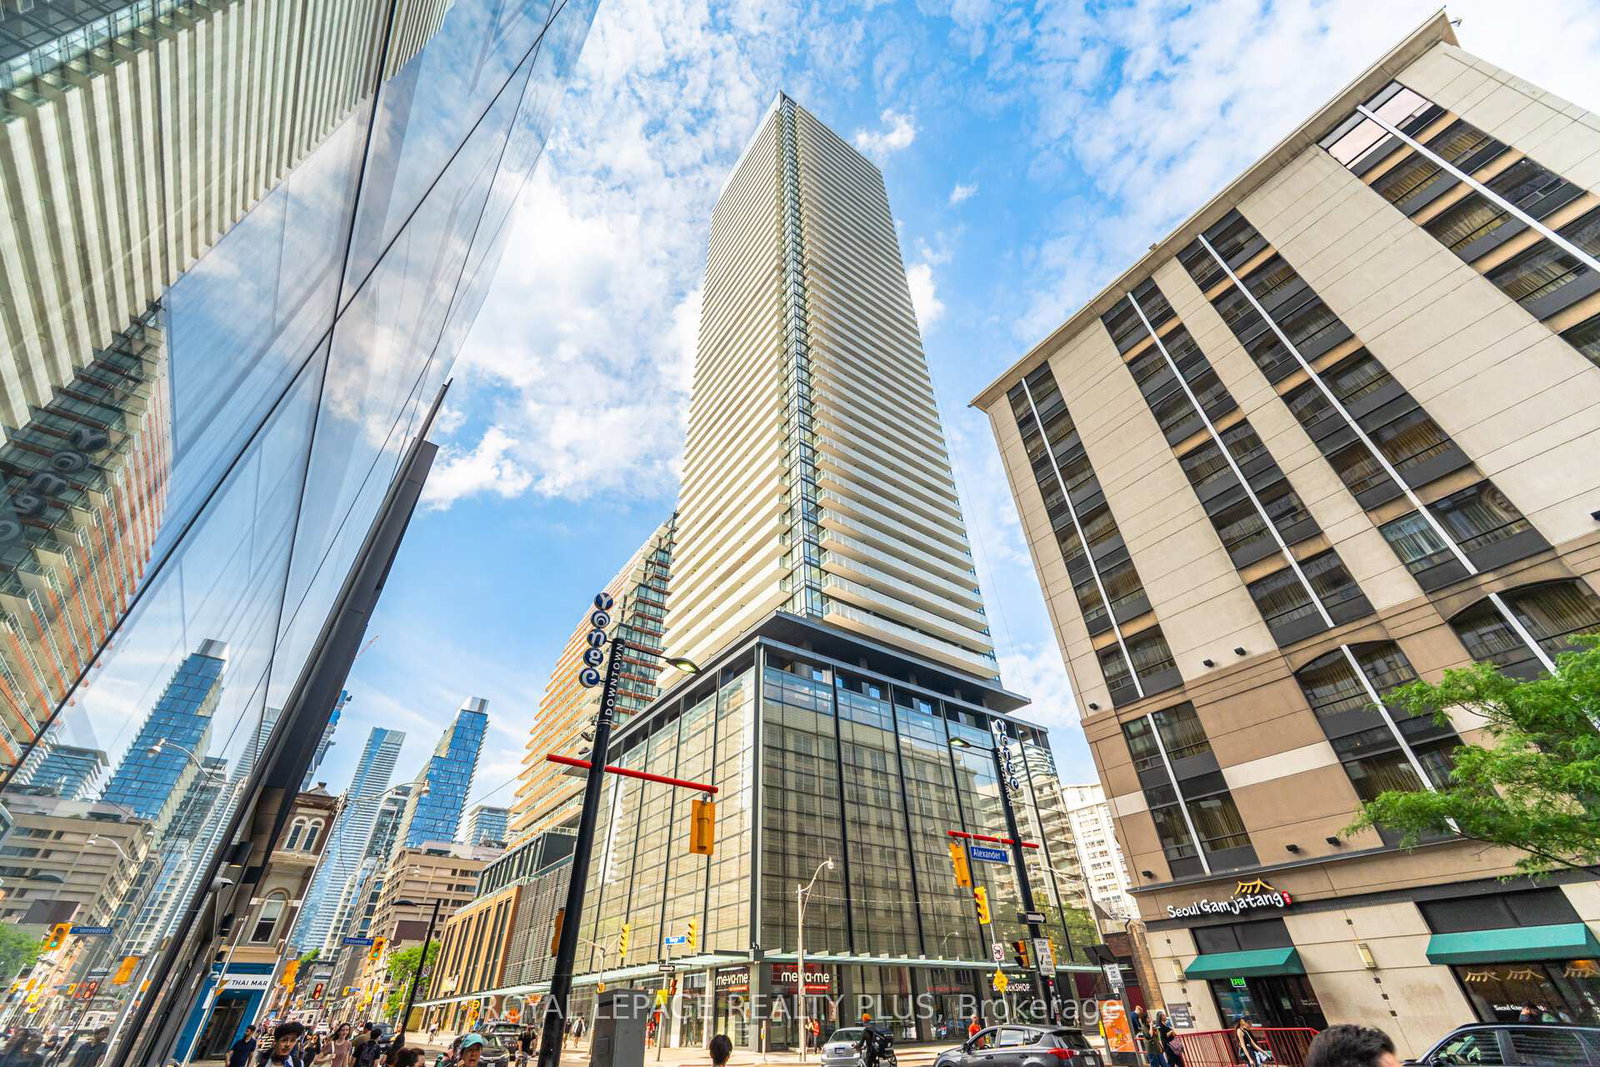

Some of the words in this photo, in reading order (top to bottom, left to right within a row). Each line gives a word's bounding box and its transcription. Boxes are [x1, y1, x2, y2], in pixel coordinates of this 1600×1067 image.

[580, 592, 613, 688] Yonge
[605, 643, 624, 717] DOWNTOWN
[973, 848, 1001, 860] Alexander
[1167, 902, 1200, 918] Seoul
[1200, 892, 1284, 915] Gamjatang
